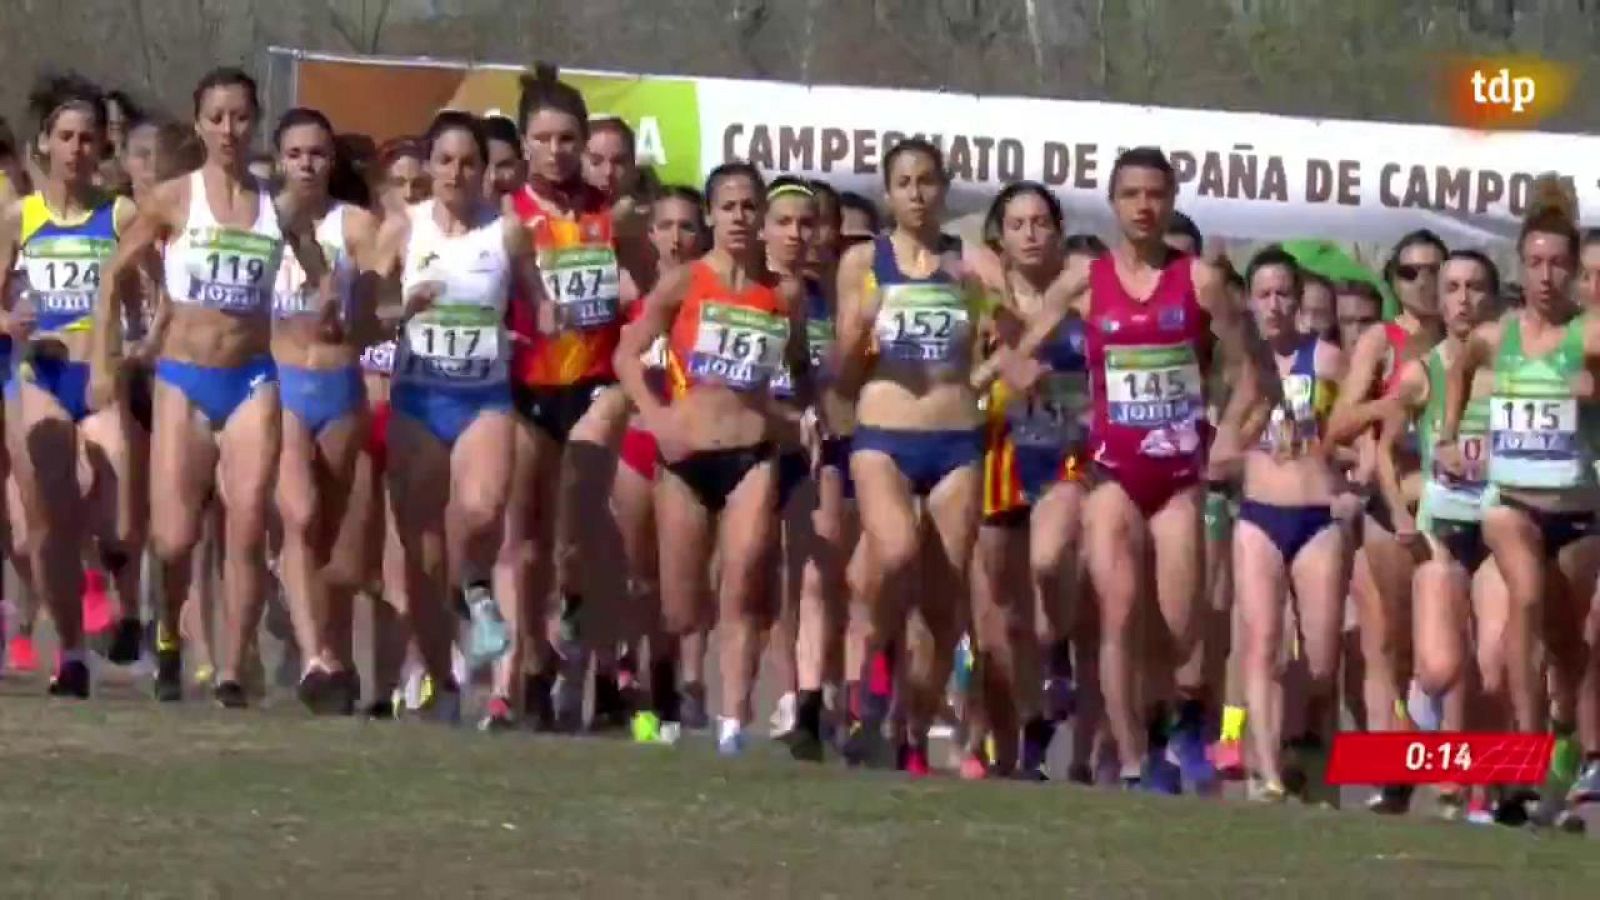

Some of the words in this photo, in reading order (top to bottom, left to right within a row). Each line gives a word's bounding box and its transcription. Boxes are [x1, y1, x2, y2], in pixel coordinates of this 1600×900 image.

[723, 122, 1025, 181] CAMPEATO
[1043, 140, 1098, 189] DE
[1117, 143, 1288, 202] PAÑA
[1305, 158, 1361, 205] DE
[1380, 162, 1535, 216] CAMPO
[45, 261, 100, 289] 124
[206, 252, 264, 282] 119
[546, 269, 602, 297] 147
[894, 310, 951, 338] 152
[422, 328, 480, 357] 117
[718, 327, 767, 361] 161
[1123, 370, 1186, 400] 145
[1502, 401, 1561, 430] 115
